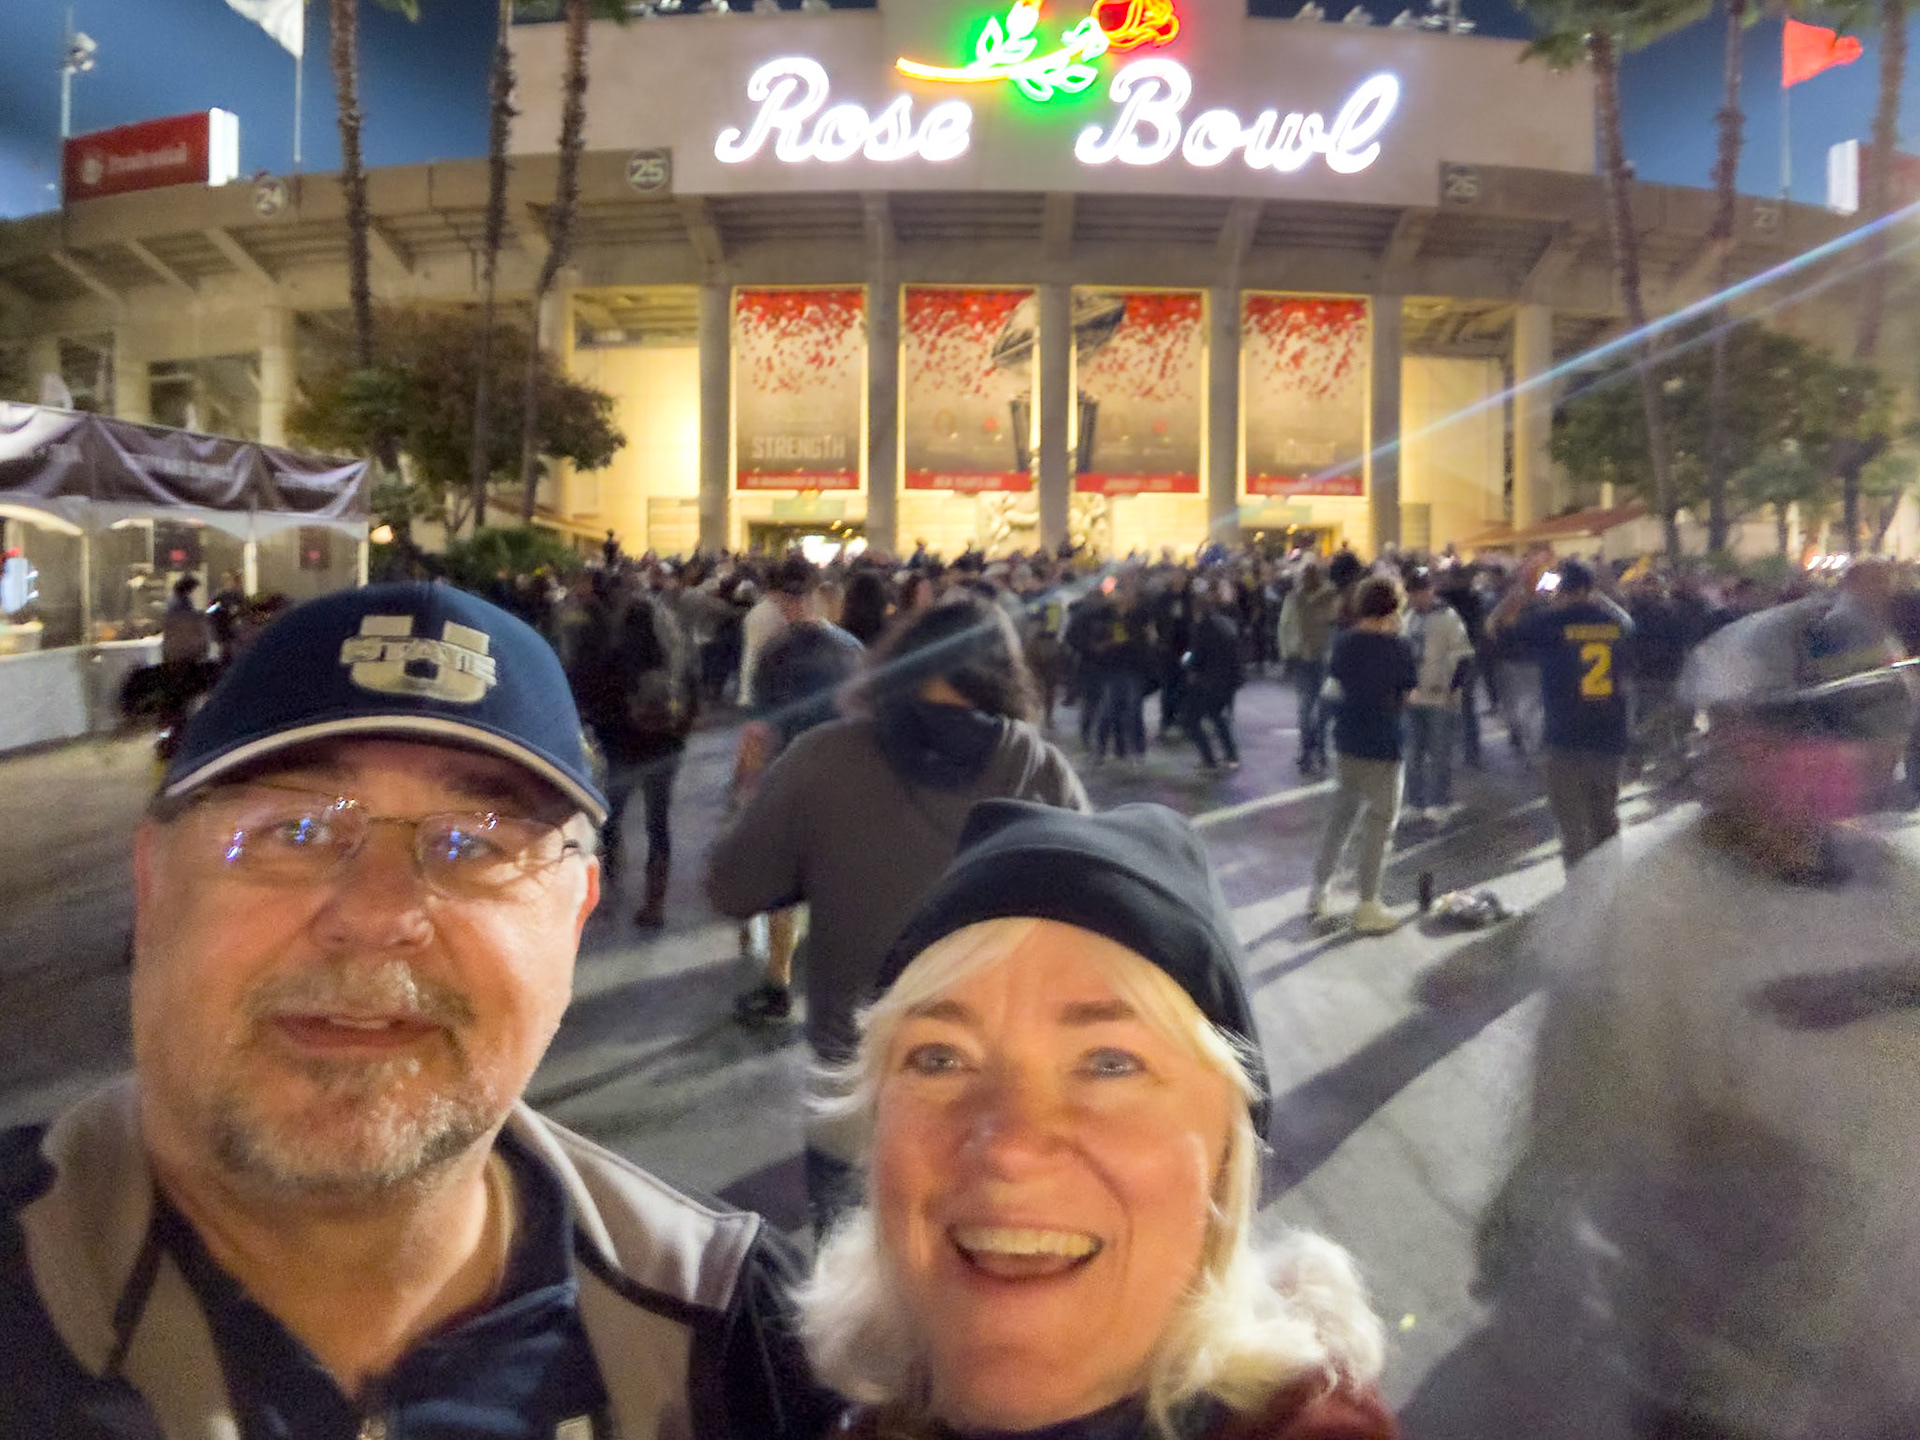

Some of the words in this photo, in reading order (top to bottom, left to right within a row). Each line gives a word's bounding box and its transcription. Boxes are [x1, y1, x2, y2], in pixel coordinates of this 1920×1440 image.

[714, 56, 974, 164] Rose
[1074, 58, 1401, 174] Bowl
[629, 158, 666, 184] 25
[1445, 173, 1477, 198] 26
[751, 434, 847, 459] STRENGTH
[1580, 641, 1613, 697] 2
